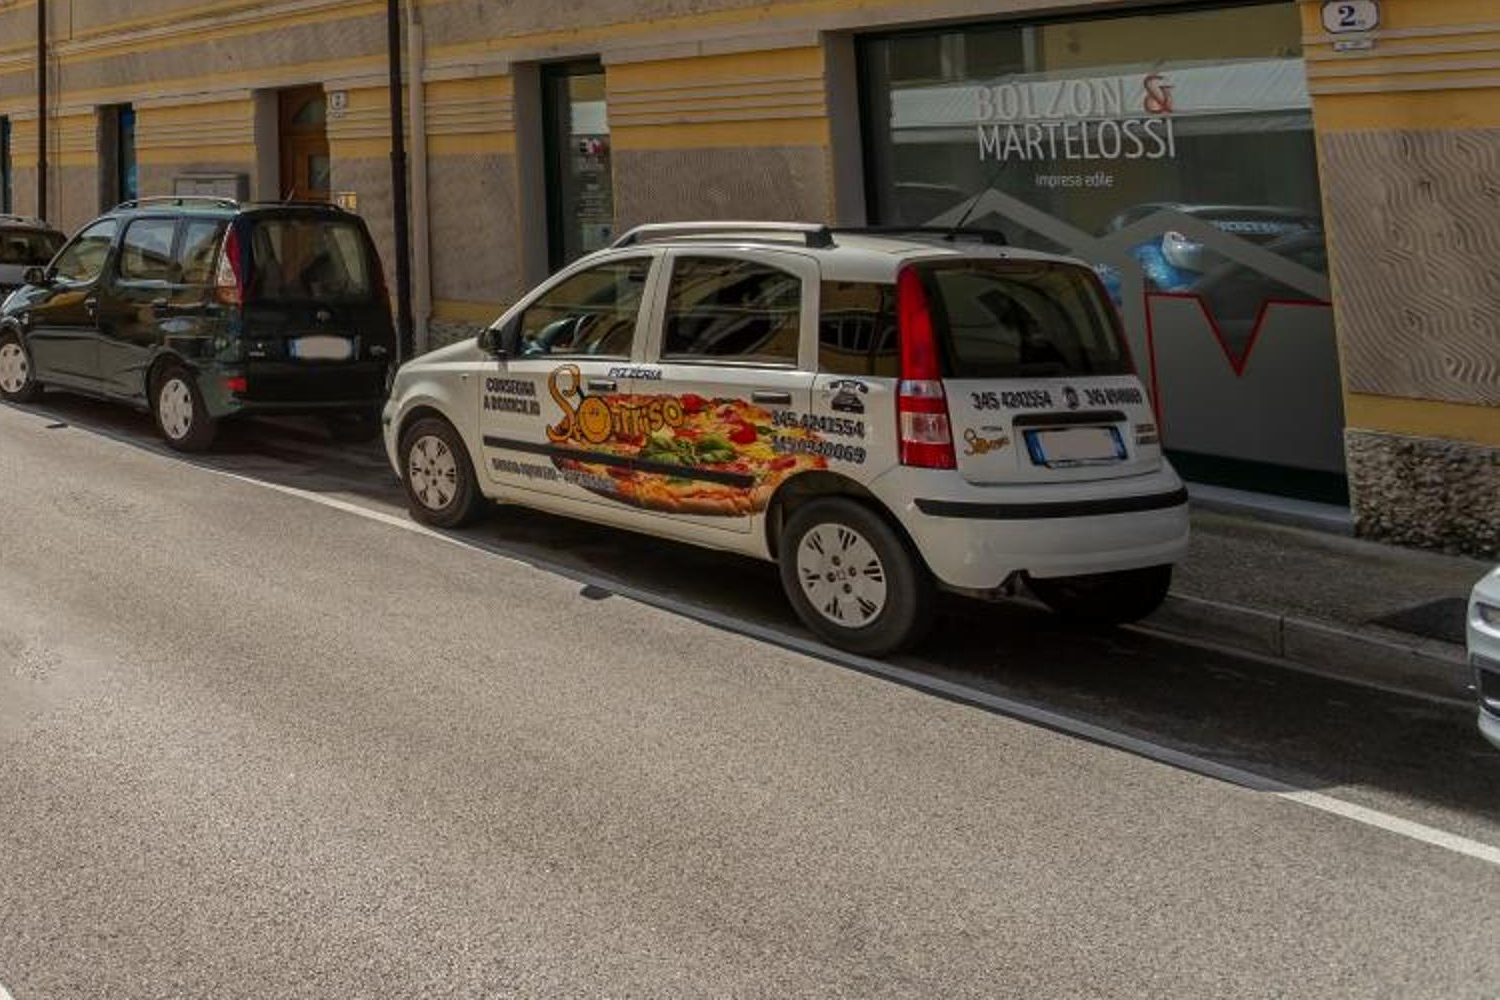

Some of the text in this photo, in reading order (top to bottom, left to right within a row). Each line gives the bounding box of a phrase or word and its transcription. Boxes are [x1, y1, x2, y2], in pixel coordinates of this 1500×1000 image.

[974, 74, 1174, 120] BOLZON &
[977, 118, 1176, 161] MARTELOSSI
[1035, 172, 1114, 188] impresa edile
